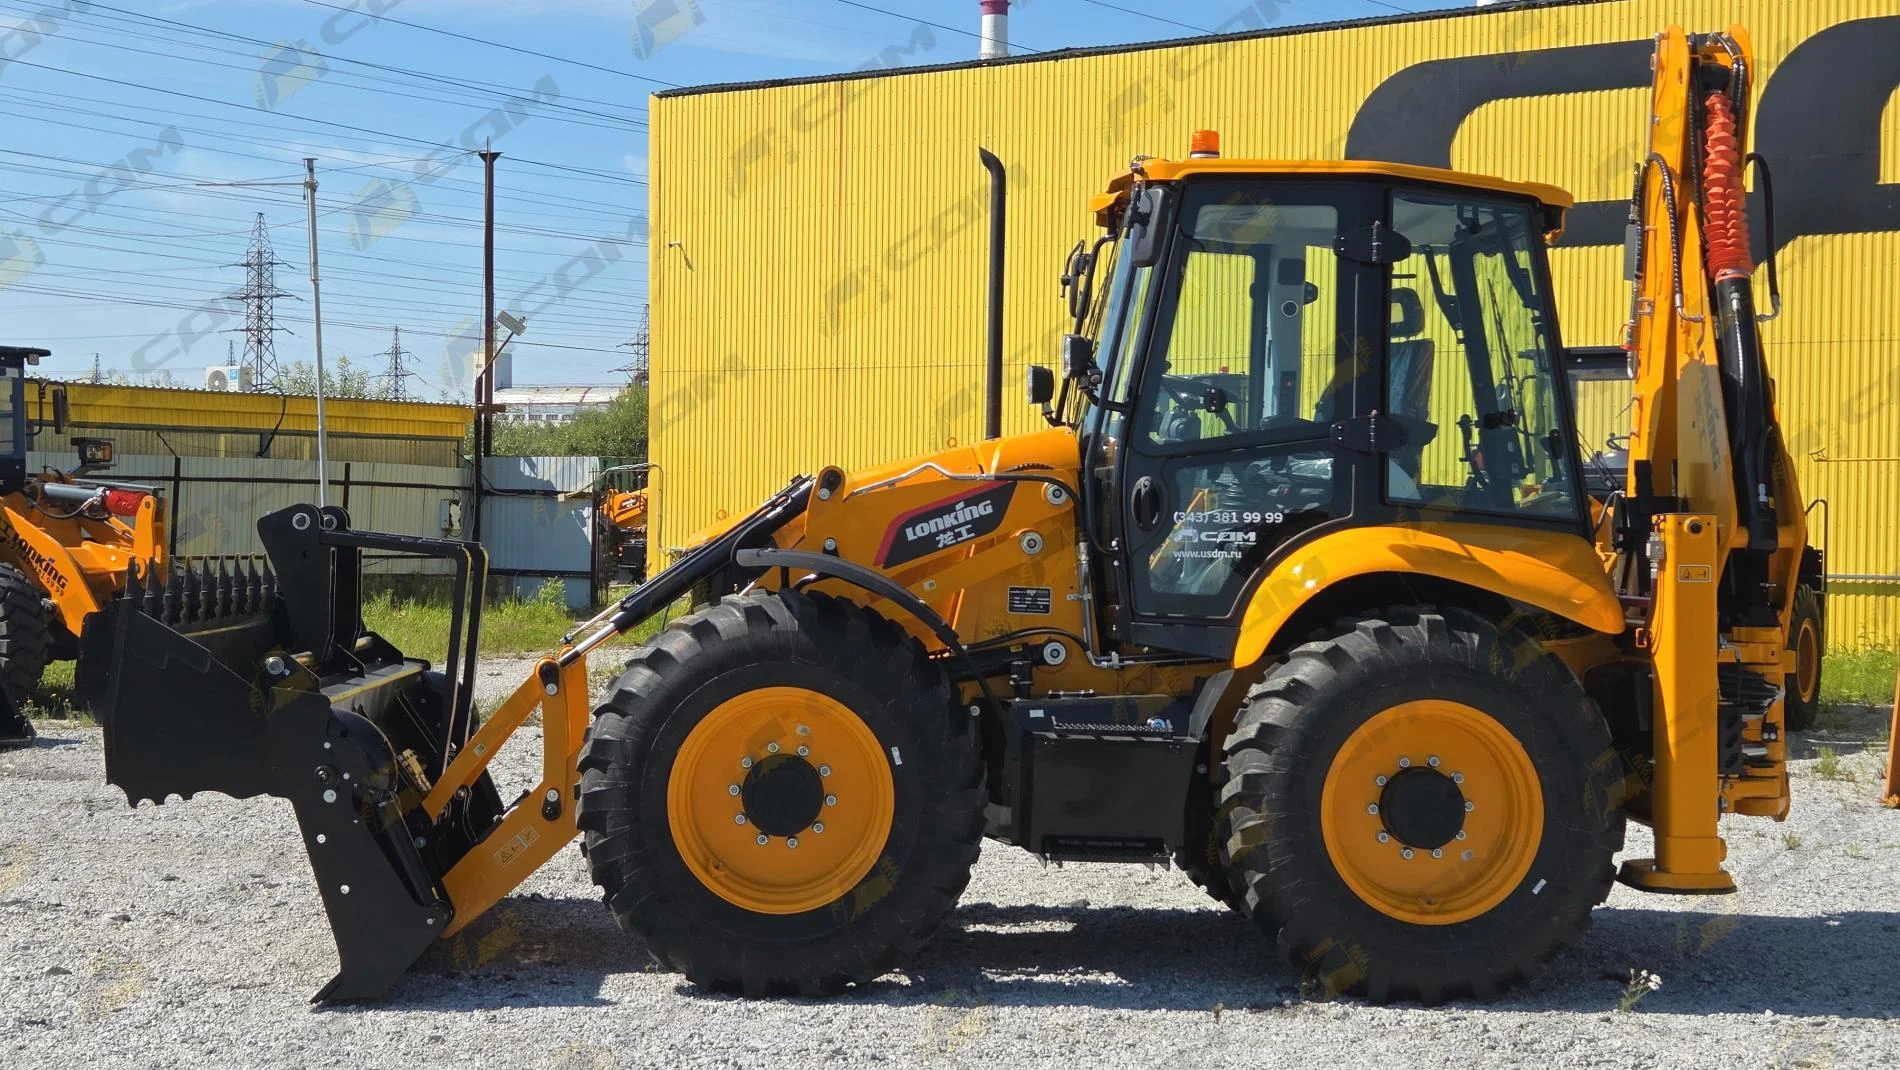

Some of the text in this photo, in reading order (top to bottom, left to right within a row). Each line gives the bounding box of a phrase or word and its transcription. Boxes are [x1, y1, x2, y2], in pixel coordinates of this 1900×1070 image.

[1173, 511, 1283, 524] (343) 381 99 99
[936, 524, 976, 548] 龙工
[1173, 549, 1242, 559] www.usdm.ru
